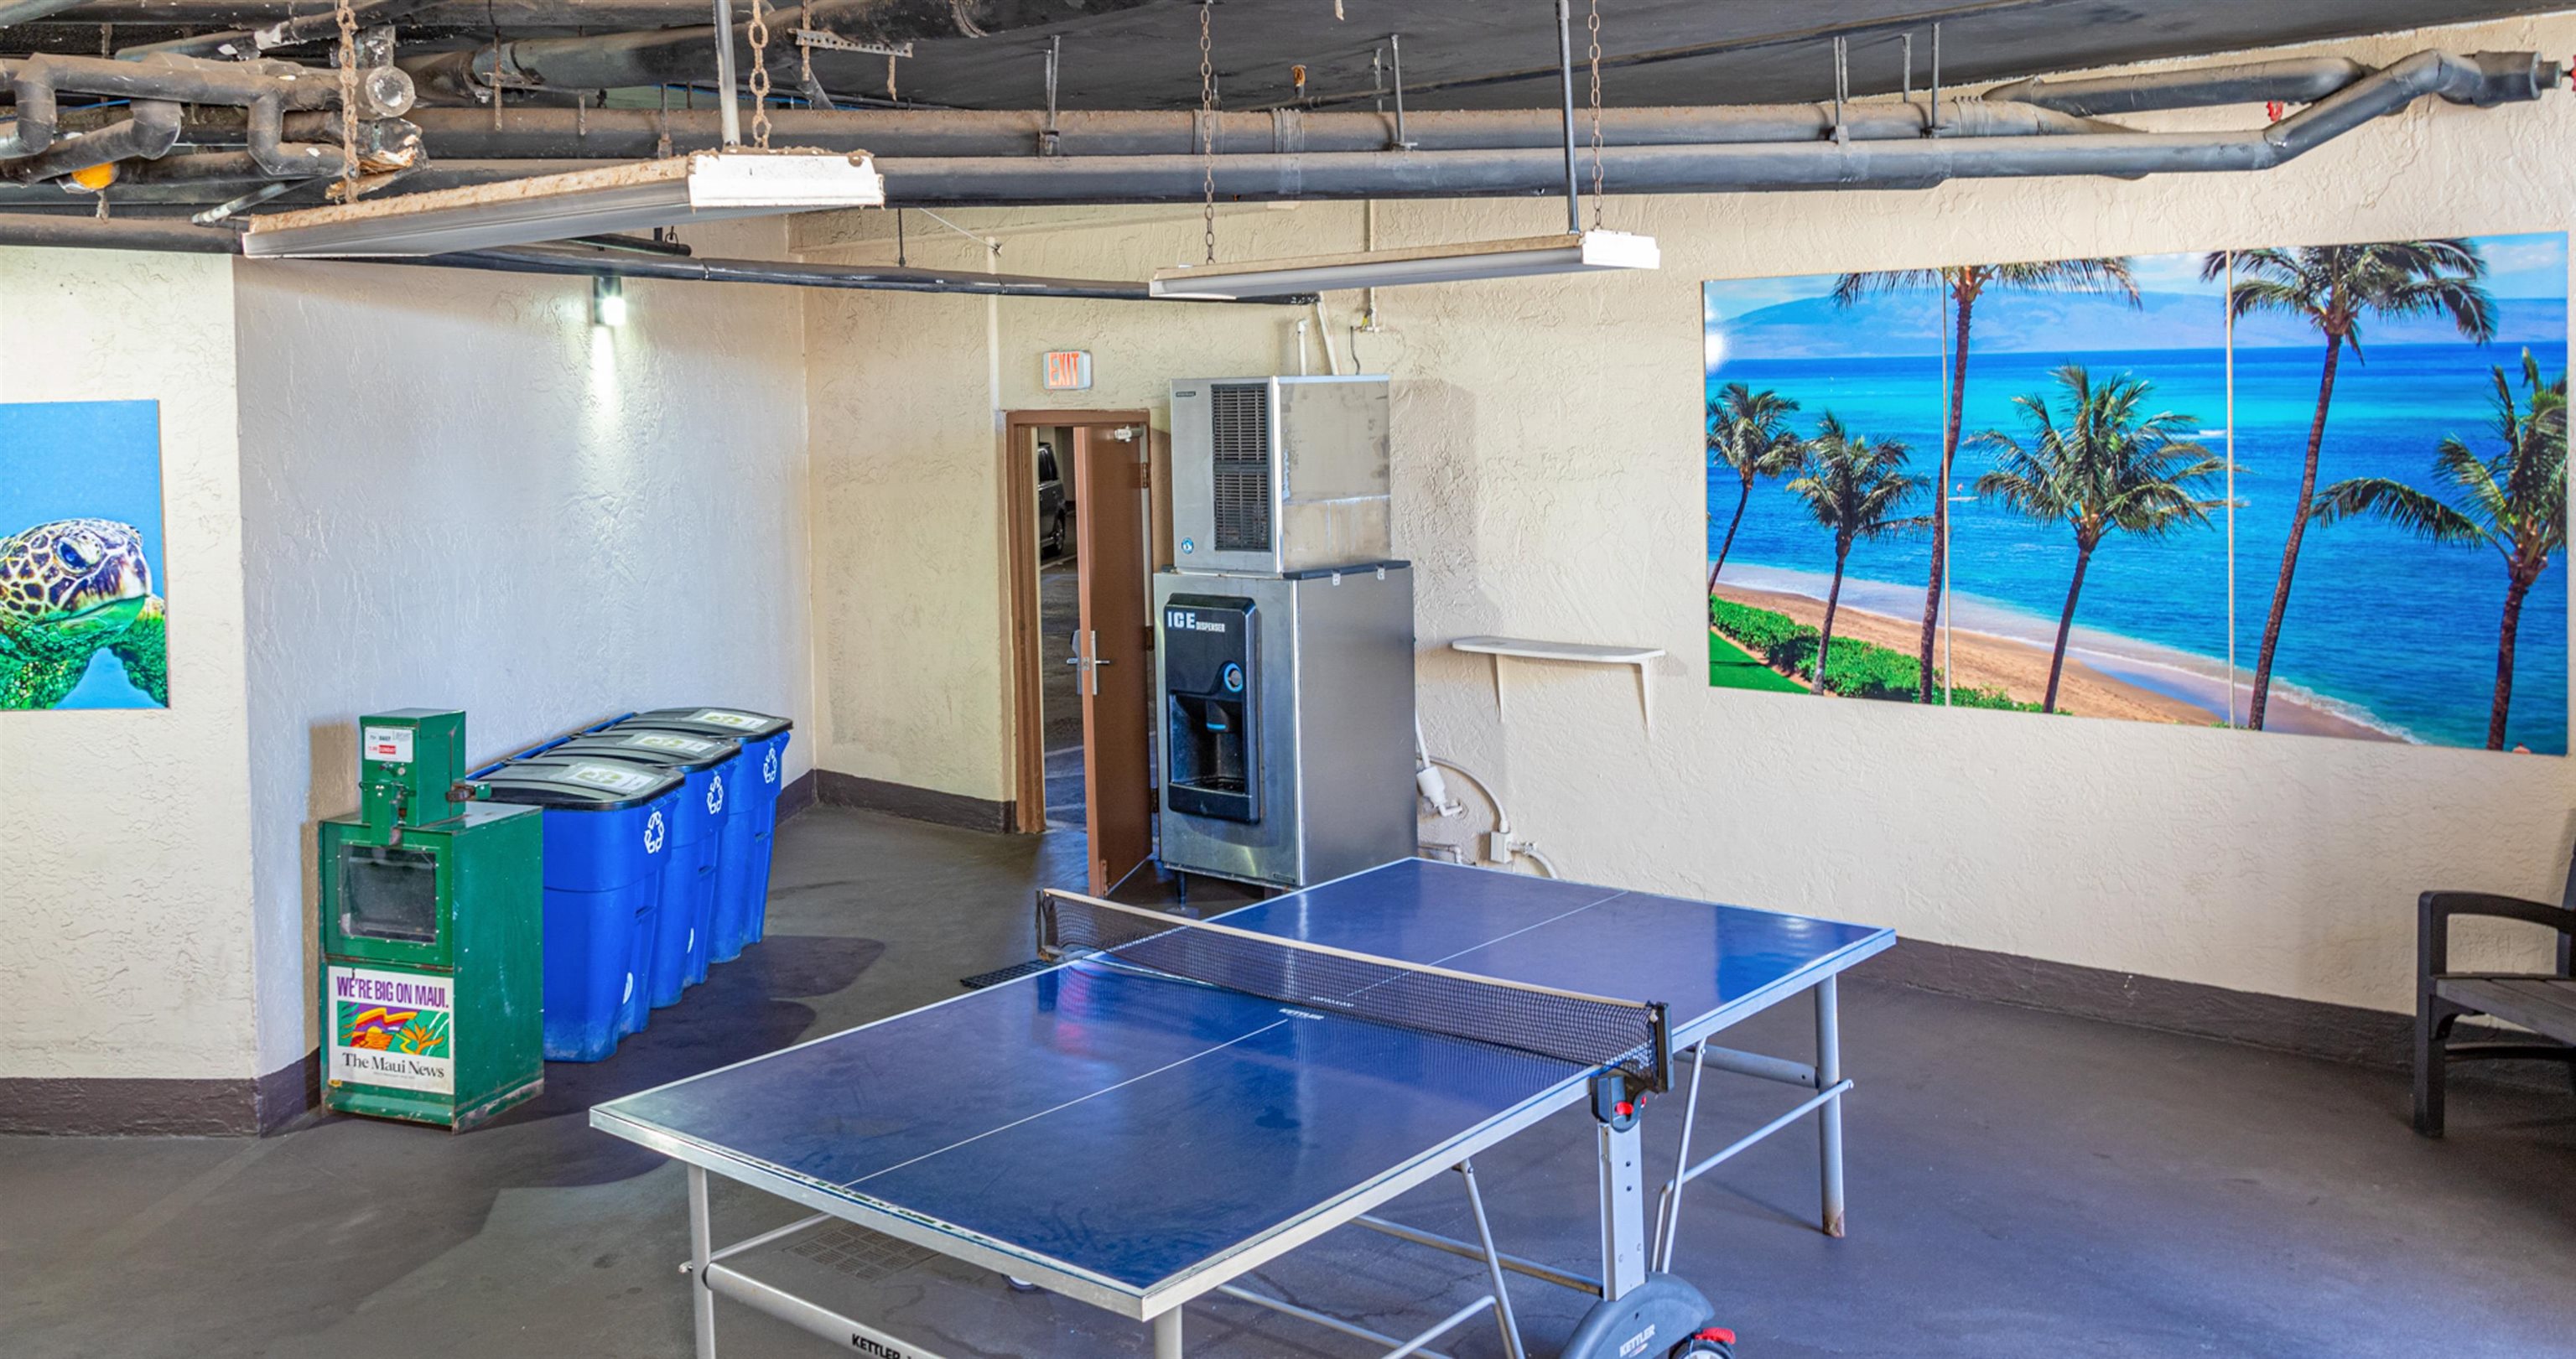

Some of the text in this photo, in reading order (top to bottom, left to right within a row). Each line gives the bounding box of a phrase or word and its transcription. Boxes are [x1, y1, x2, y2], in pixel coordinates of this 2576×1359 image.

[1049, 352, 1079, 386] EXIT
[1167, 611, 1196, 629] ICE
[336, 976, 449, 1008] WE'RE BIG ON MAUI.
[342, 1052, 369, 1069] The
[371, 1056, 406, 1073] Maui
[408, 1061, 444, 1078] News
[1619, 1324, 1655, 1357] KETTLER
